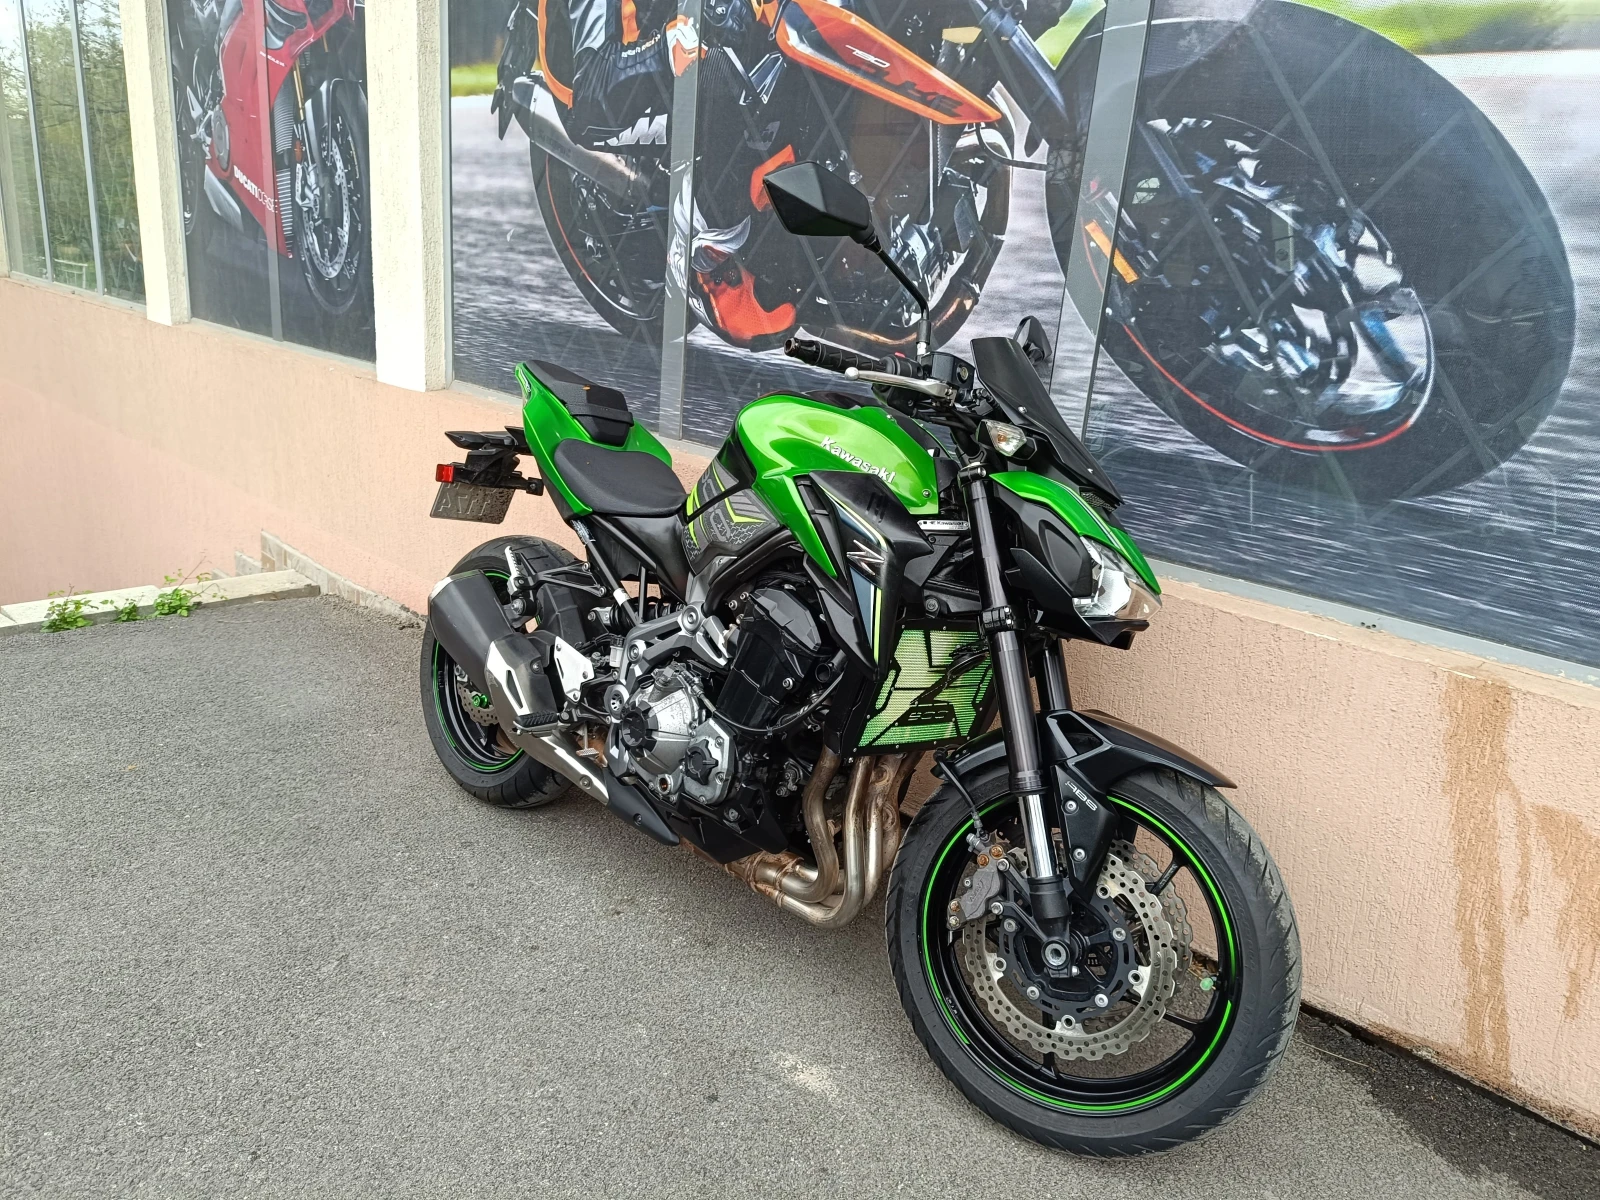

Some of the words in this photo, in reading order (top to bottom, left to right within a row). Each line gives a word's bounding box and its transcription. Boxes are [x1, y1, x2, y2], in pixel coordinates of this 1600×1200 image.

[233, 165, 258, 199] DUCATI
[820, 436, 897, 484] Kawasaki
[1065, 780, 1098, 812] ABS
